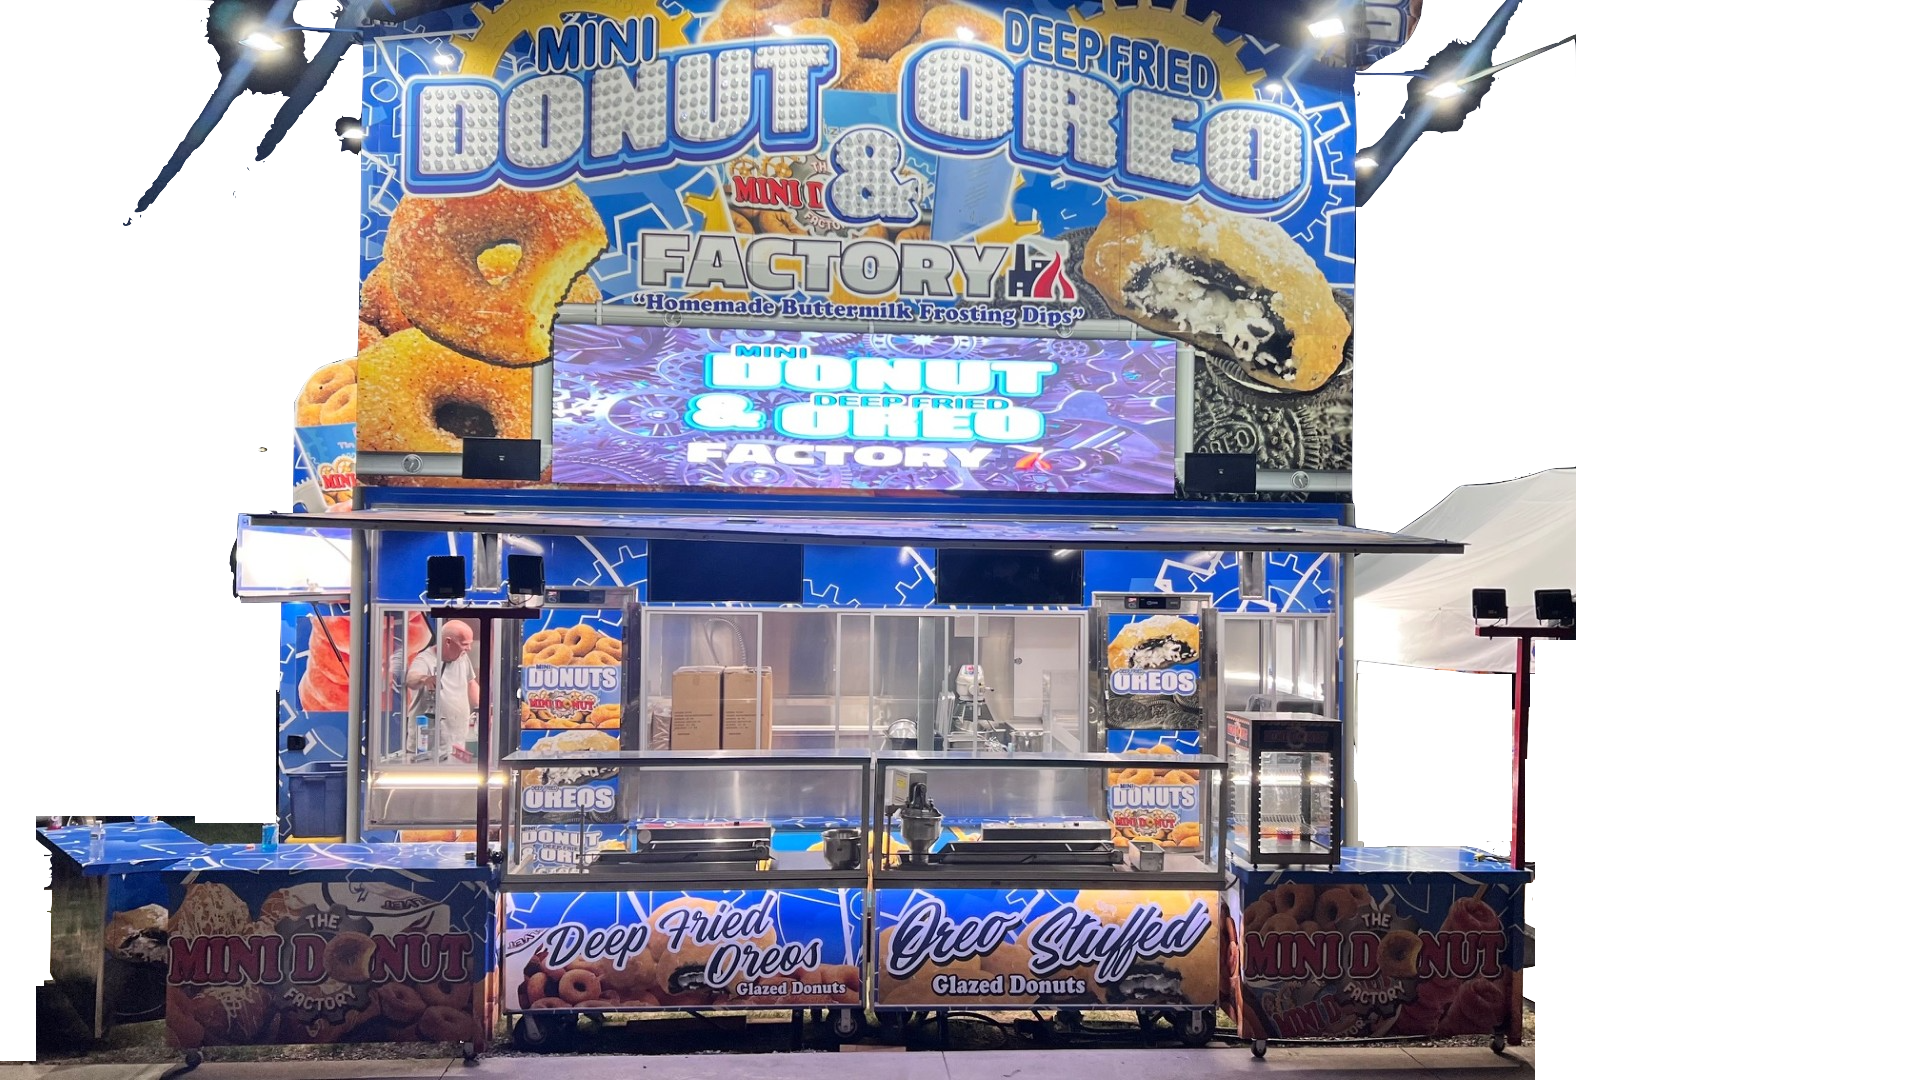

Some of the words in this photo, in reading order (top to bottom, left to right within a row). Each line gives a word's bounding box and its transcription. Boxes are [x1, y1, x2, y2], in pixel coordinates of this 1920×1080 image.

[538, 16, 656, 74] MINI
[1004, 10, 1101, 73] DEEP
[1108, 34, 1218, 99] FRIED
[410, 40, 837, 188] DONUT
[905, 42, 1308, 210] OREO
[828, 127, 921, 223] &
[732, 176, 803, 207] MINI
[803, 212, 846, 232] FACTO
[641, 232, 1008, 298] FACTORY
[781, 298, 912, 320] Buttermilk
[919, 304, 1016, 326] Frosting
[735, 345, 808, 359] MINI
[706, 354, 1055, 396] DONUT
[814, 395, 903, 408] DEEP
[911, 396, 1009, 410] FRIED
[686, 394, 766, 431] &
[775, 402, 1044, 442] OREO
[687, 442, 993, 467] FACTORY
[527, 667, 617, 690] DONUTS
[1112, 671, 1196, 694] OREOS
[523, 787, 613, 811] OREOS
[1112, 786, 1196, 809] DONUTS
[521, 829, 600, 847] DONUT
[305, 913, 340, 930] THE
[547, 925, 648, 968] Deep
[659, 894, 776, 950] Fried
[1361, 912, 1391, 929] THE
[889, 903, 1024, 974] Oreo
[1029, 899, 1211, 982] Stuffed
[168, 933, 284, 985] MINI
[706, 941, 822, 986] Oreos
[1245, 932, 1343, 979] MINI
[283, 985, 356, 1011] FACTORY
[737, 981, 787, 996] Glazed
[791, 981, 845, 996] Donuts
[932, 975, 1003, 995] Glazed
[1008, 976, 1086, 995] Donuts
[1343, 982, 1406, 1005] FACTORY
